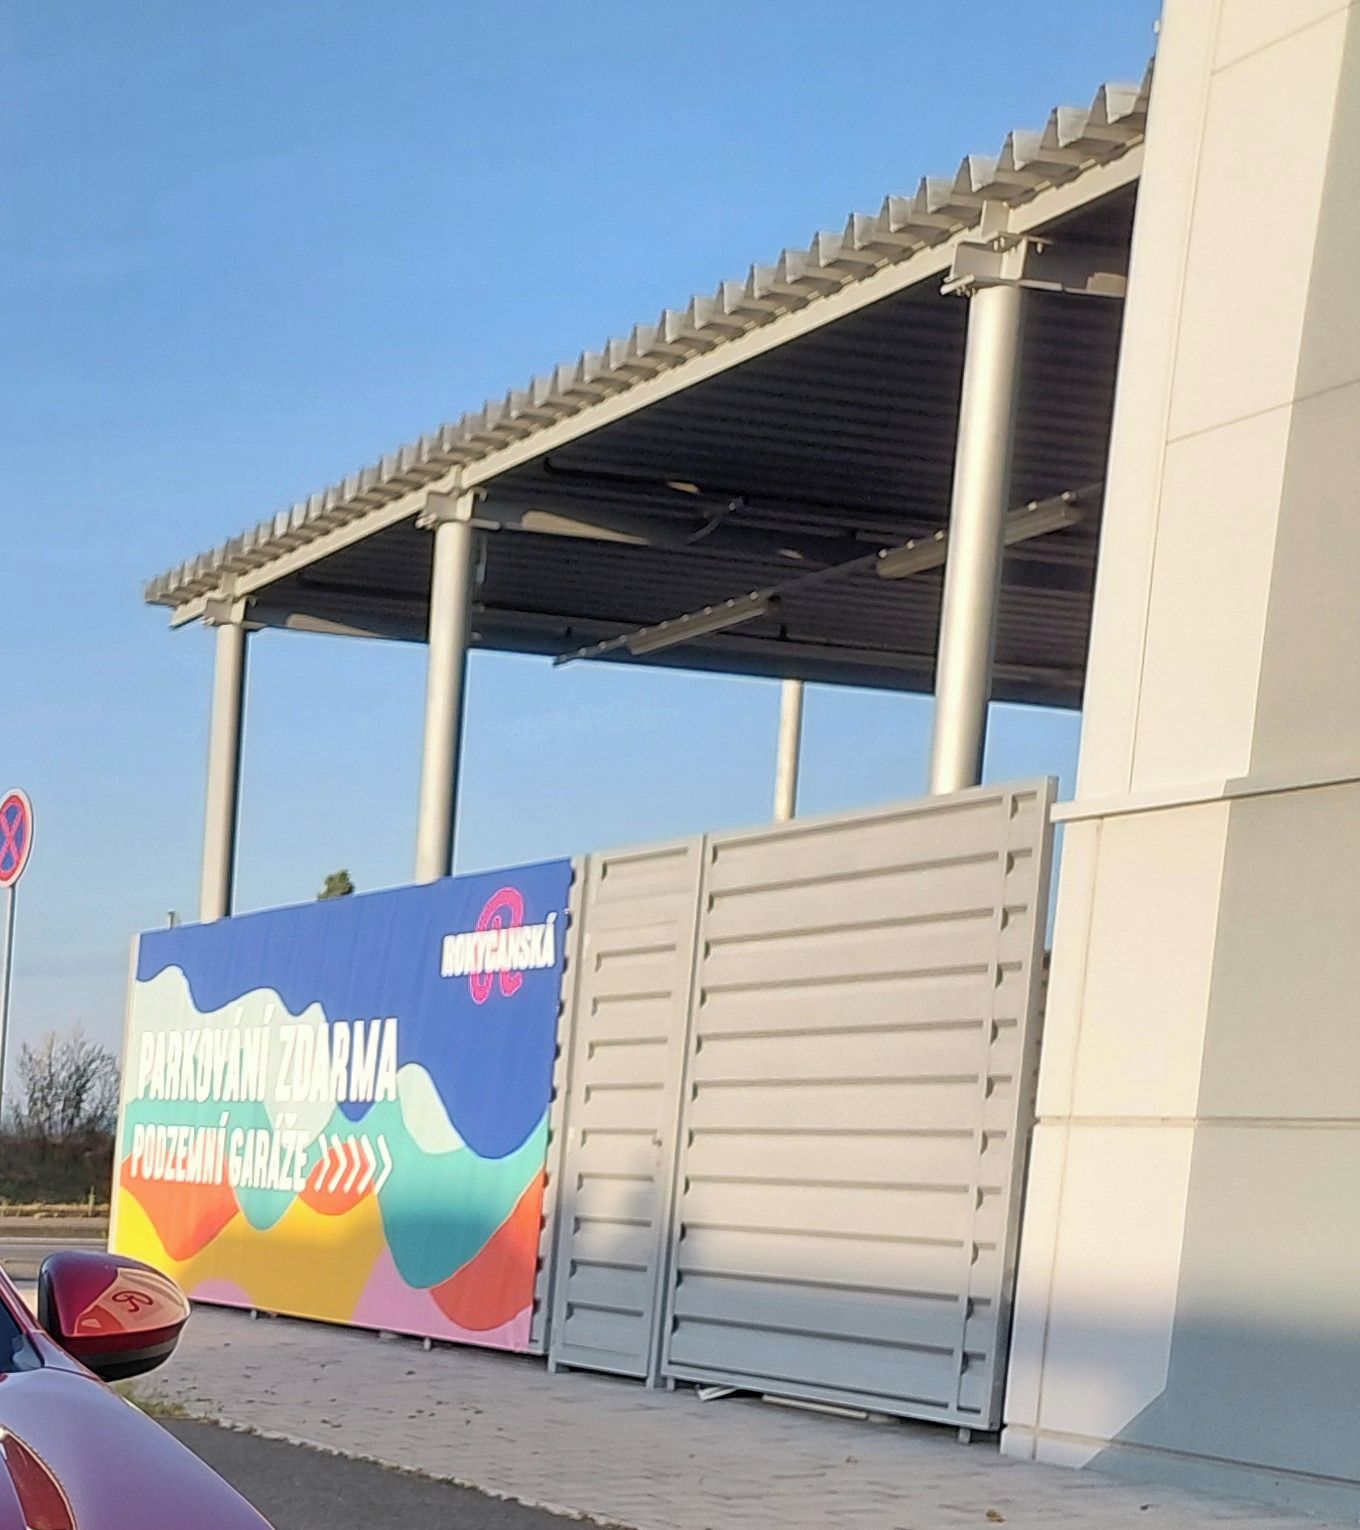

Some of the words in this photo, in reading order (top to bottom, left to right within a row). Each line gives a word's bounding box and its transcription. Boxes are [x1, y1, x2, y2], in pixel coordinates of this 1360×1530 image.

[137, 1004, 276, 1102] PARKOVÁNÍ
[275, 1017, 399, 1103] ZDARMA
[130, 1112, 229, 1186] PODZEMNÍ
[229, 1112, 309, 1193] GARÁŽE
